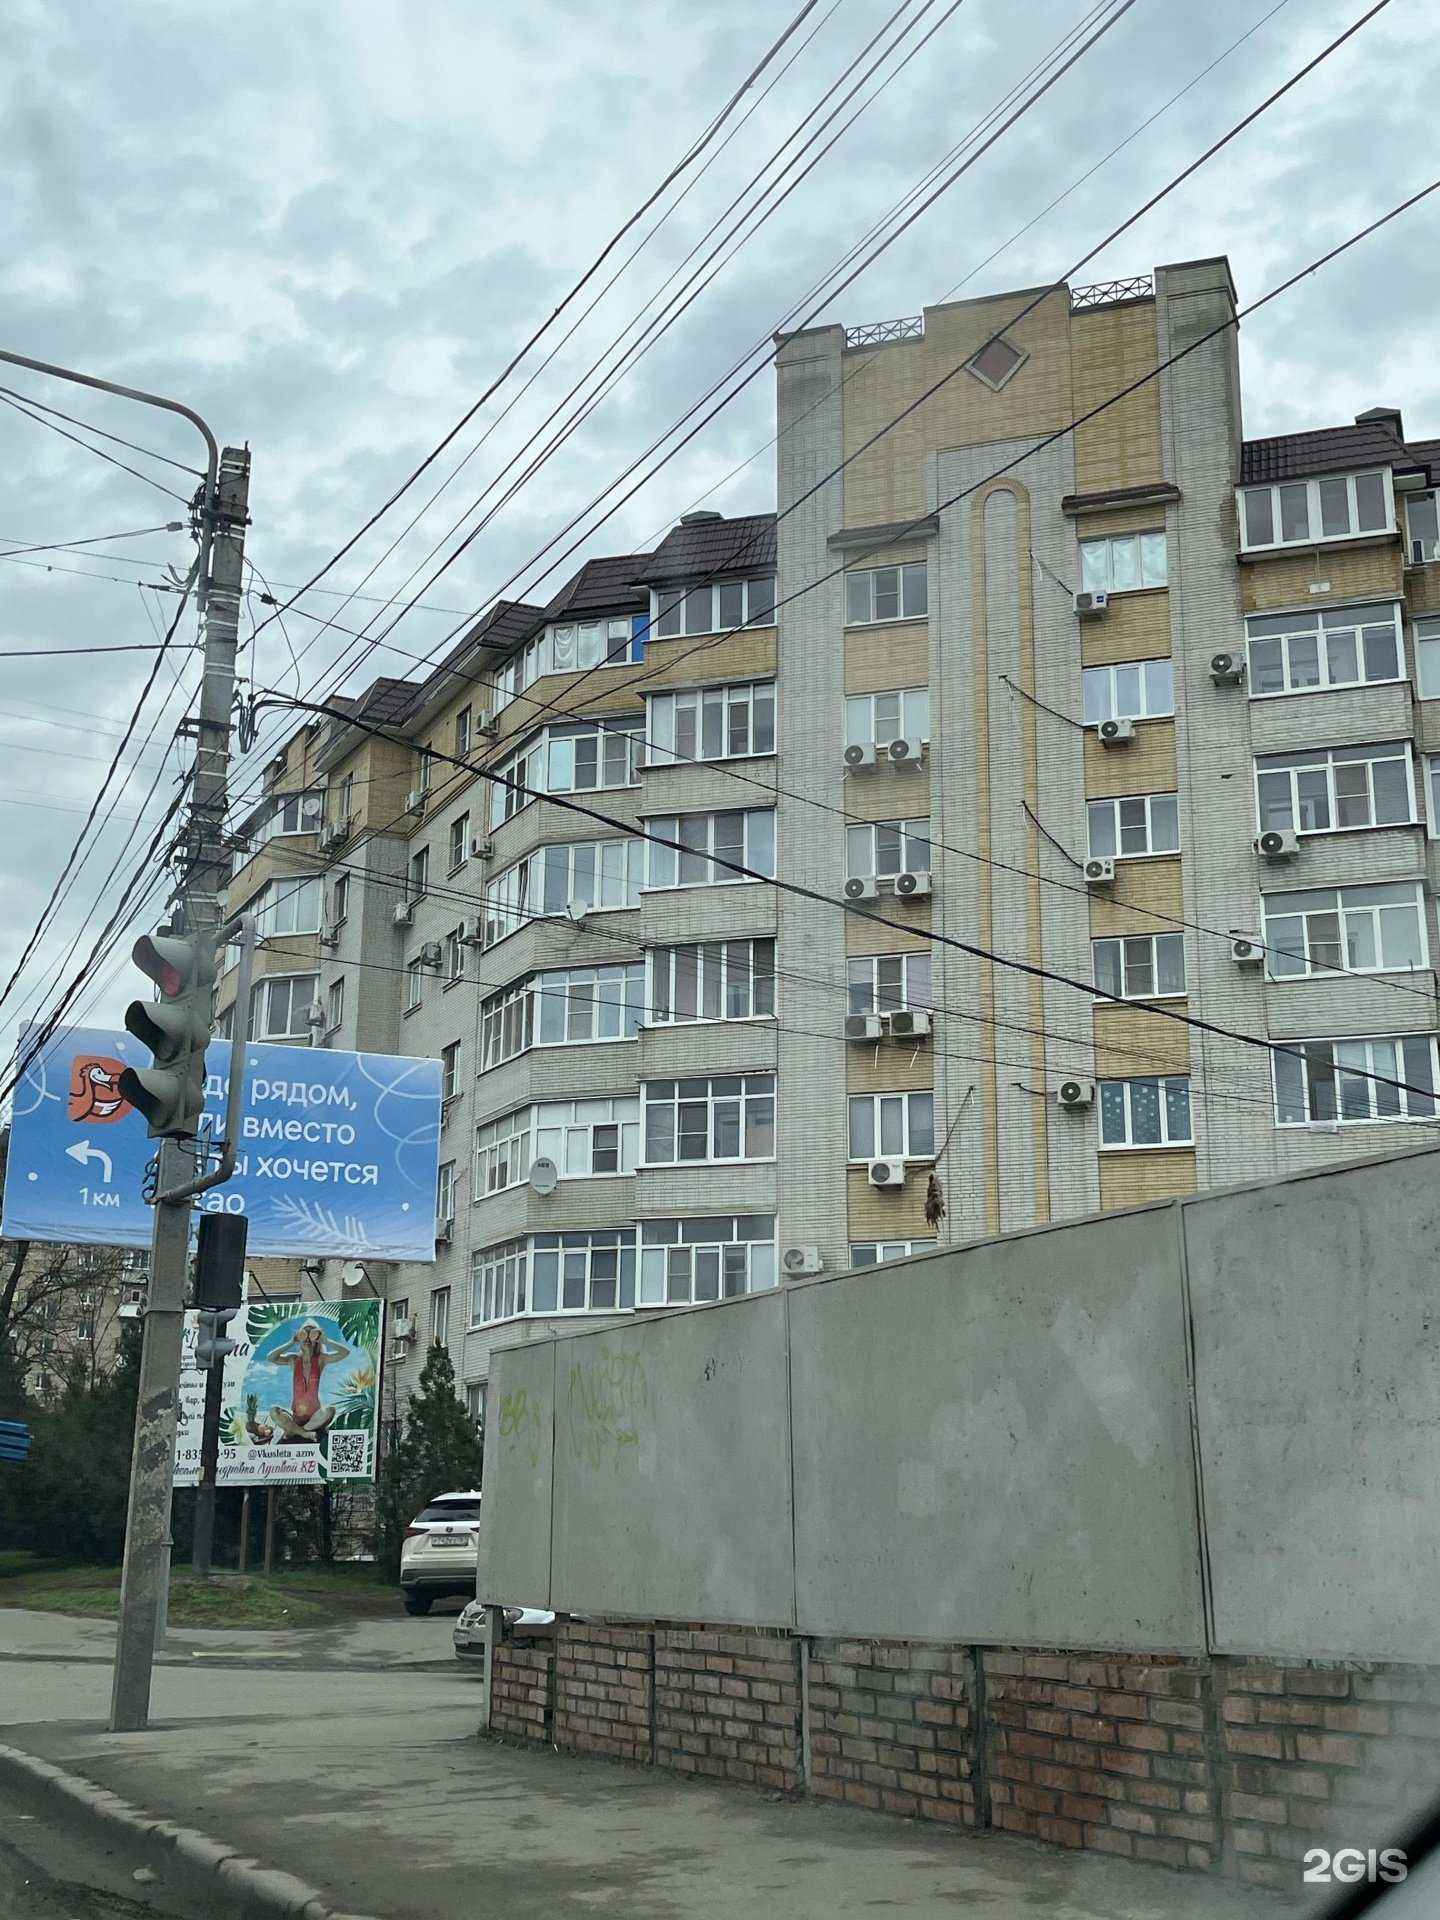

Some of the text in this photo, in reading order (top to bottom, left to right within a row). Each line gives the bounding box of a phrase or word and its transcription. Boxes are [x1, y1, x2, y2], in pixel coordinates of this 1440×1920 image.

[251, 1078, 357, 1111] рядом,
[243, 1116, 355, 1145] вместо
[256, 1156, 379, 1185] хочется
